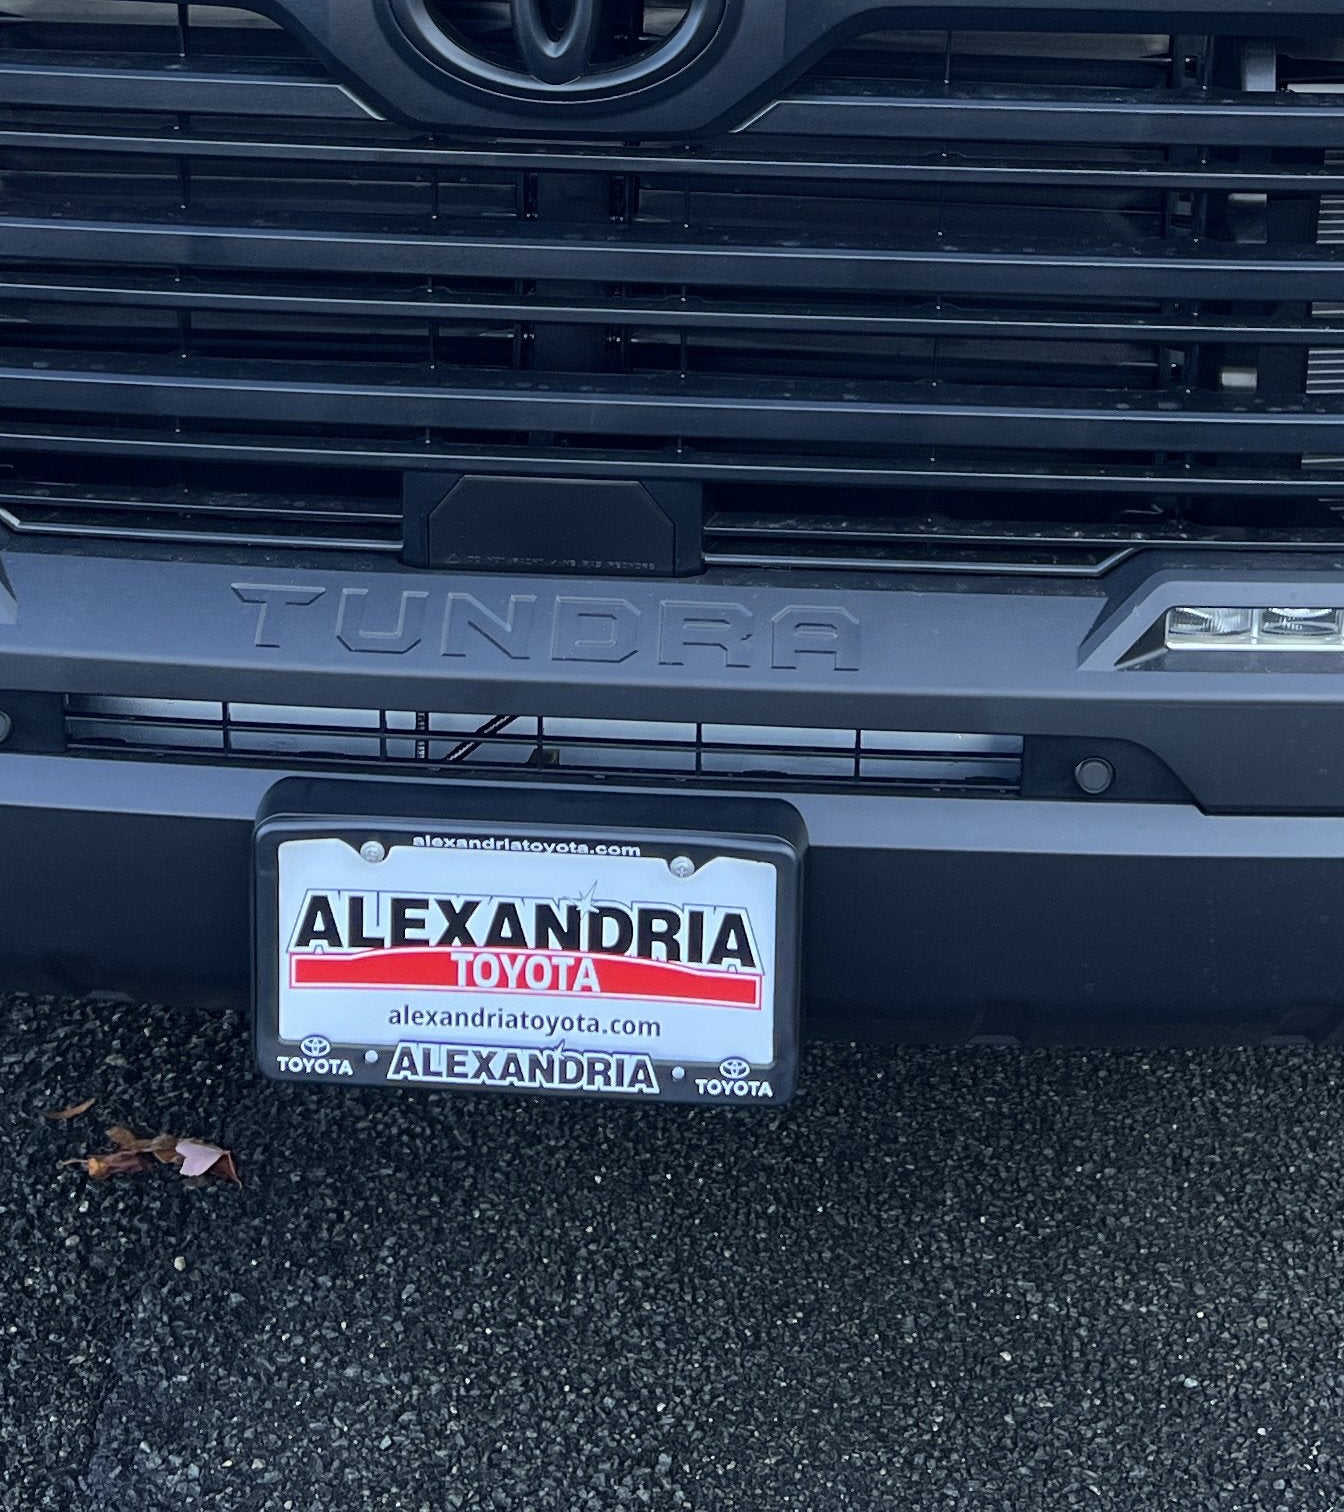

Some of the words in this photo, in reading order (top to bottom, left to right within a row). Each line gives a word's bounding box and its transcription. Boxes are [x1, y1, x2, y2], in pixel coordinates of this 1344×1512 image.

[230, 582, 860, 672] TUNDRA
[412, 834, 641, 857] alexandriatoyota.com
[293, 892, 758, 972] ALEXANDRIA
[450, 951, 601, 994] TOYOTA
[387, 1004, 662, 1037] alexandriatoyota.com
[276, 1055, 354, 1076] TOYOTA
[388, 1043, 659, 1093] ALEXANDRIA
[694, 1078, 774, 1098] TOYOTA
